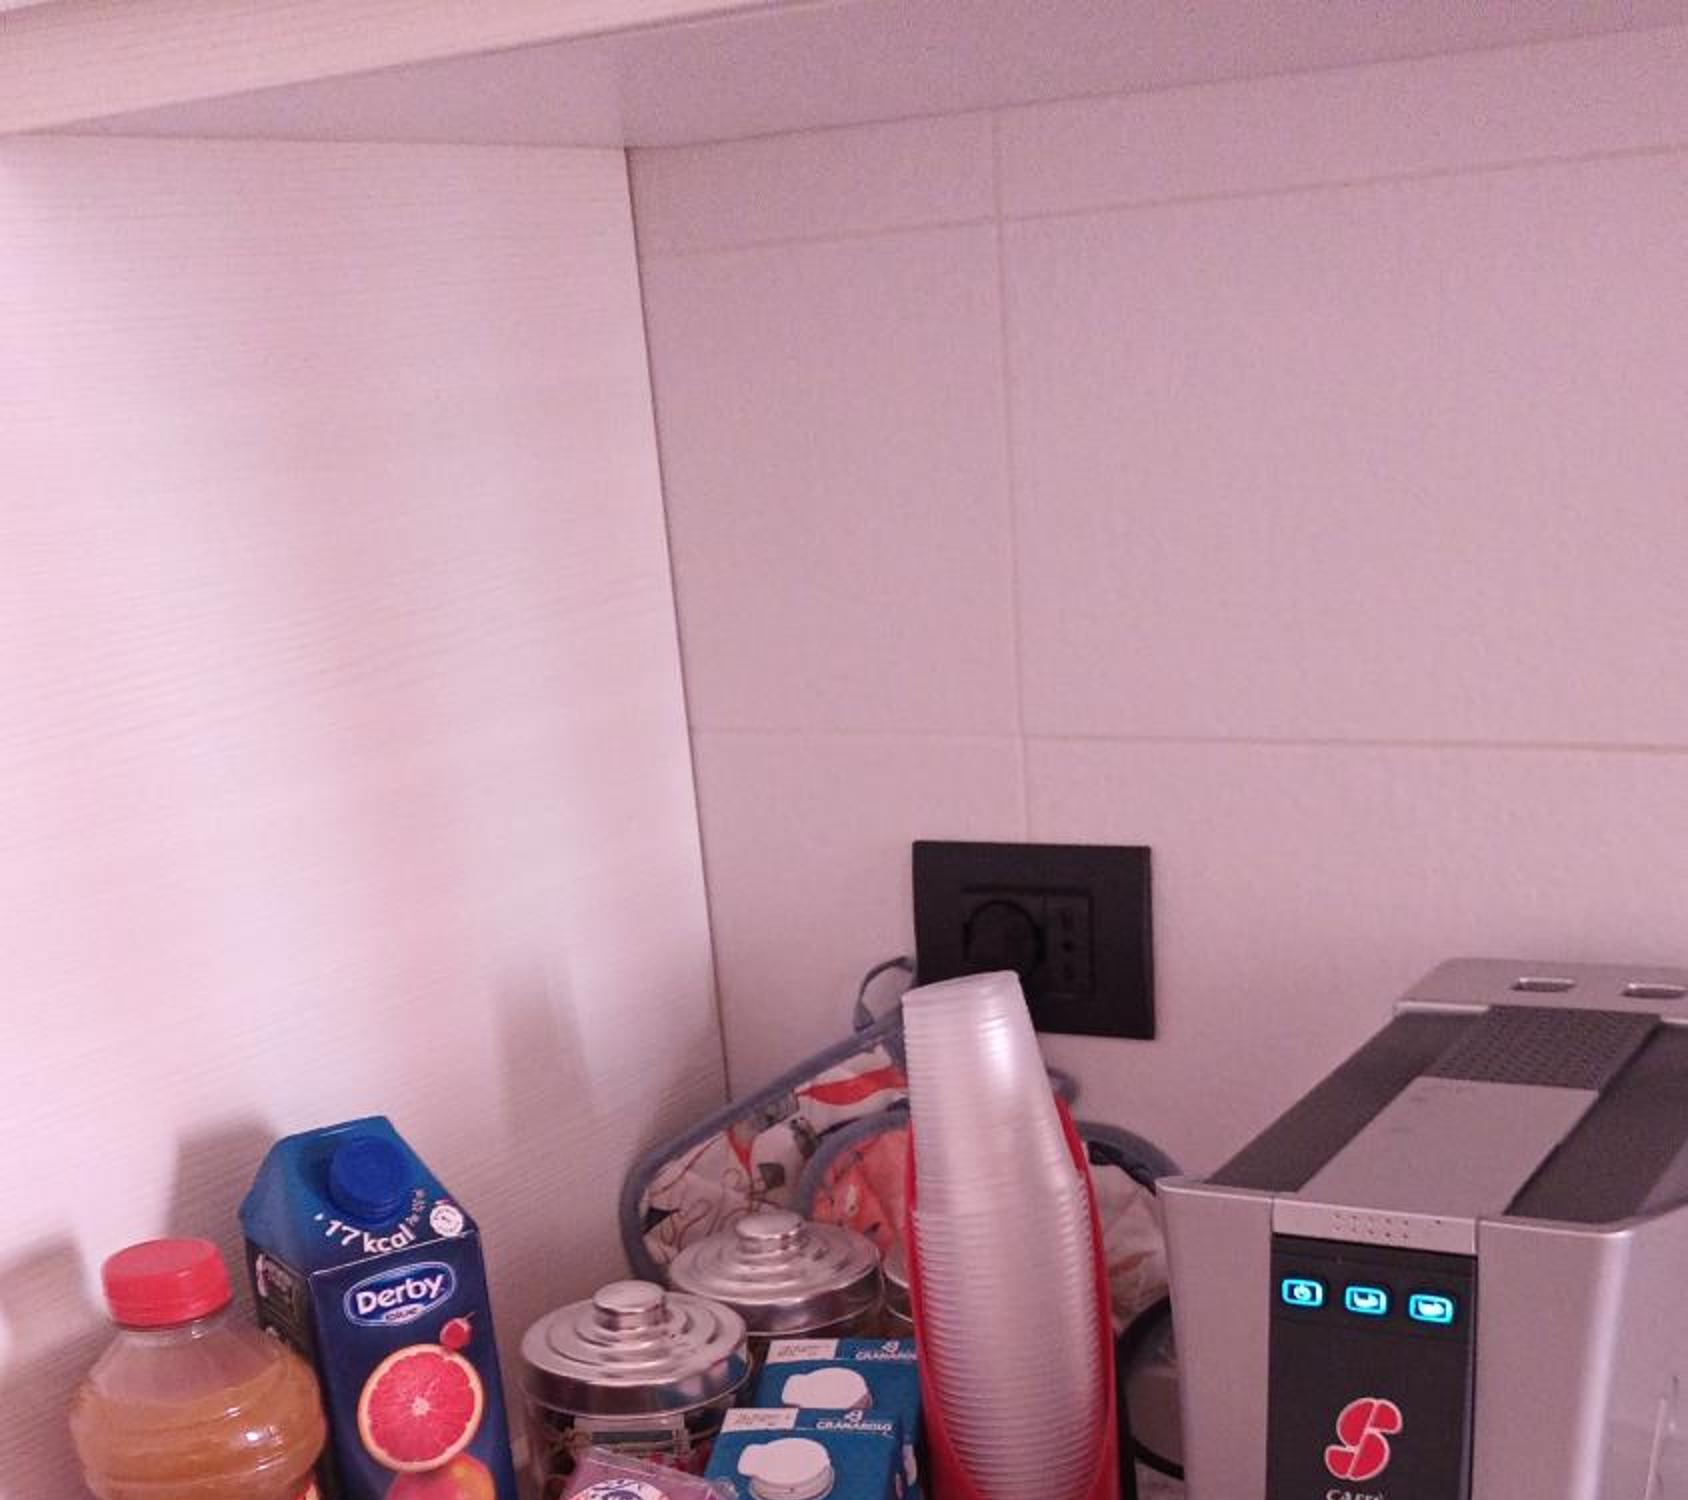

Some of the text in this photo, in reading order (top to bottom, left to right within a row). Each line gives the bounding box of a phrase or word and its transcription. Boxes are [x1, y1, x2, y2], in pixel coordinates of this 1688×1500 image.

[325, 1220, 416, 1253] 17 kcal
[356, 1274, 445, 1315] Derby
